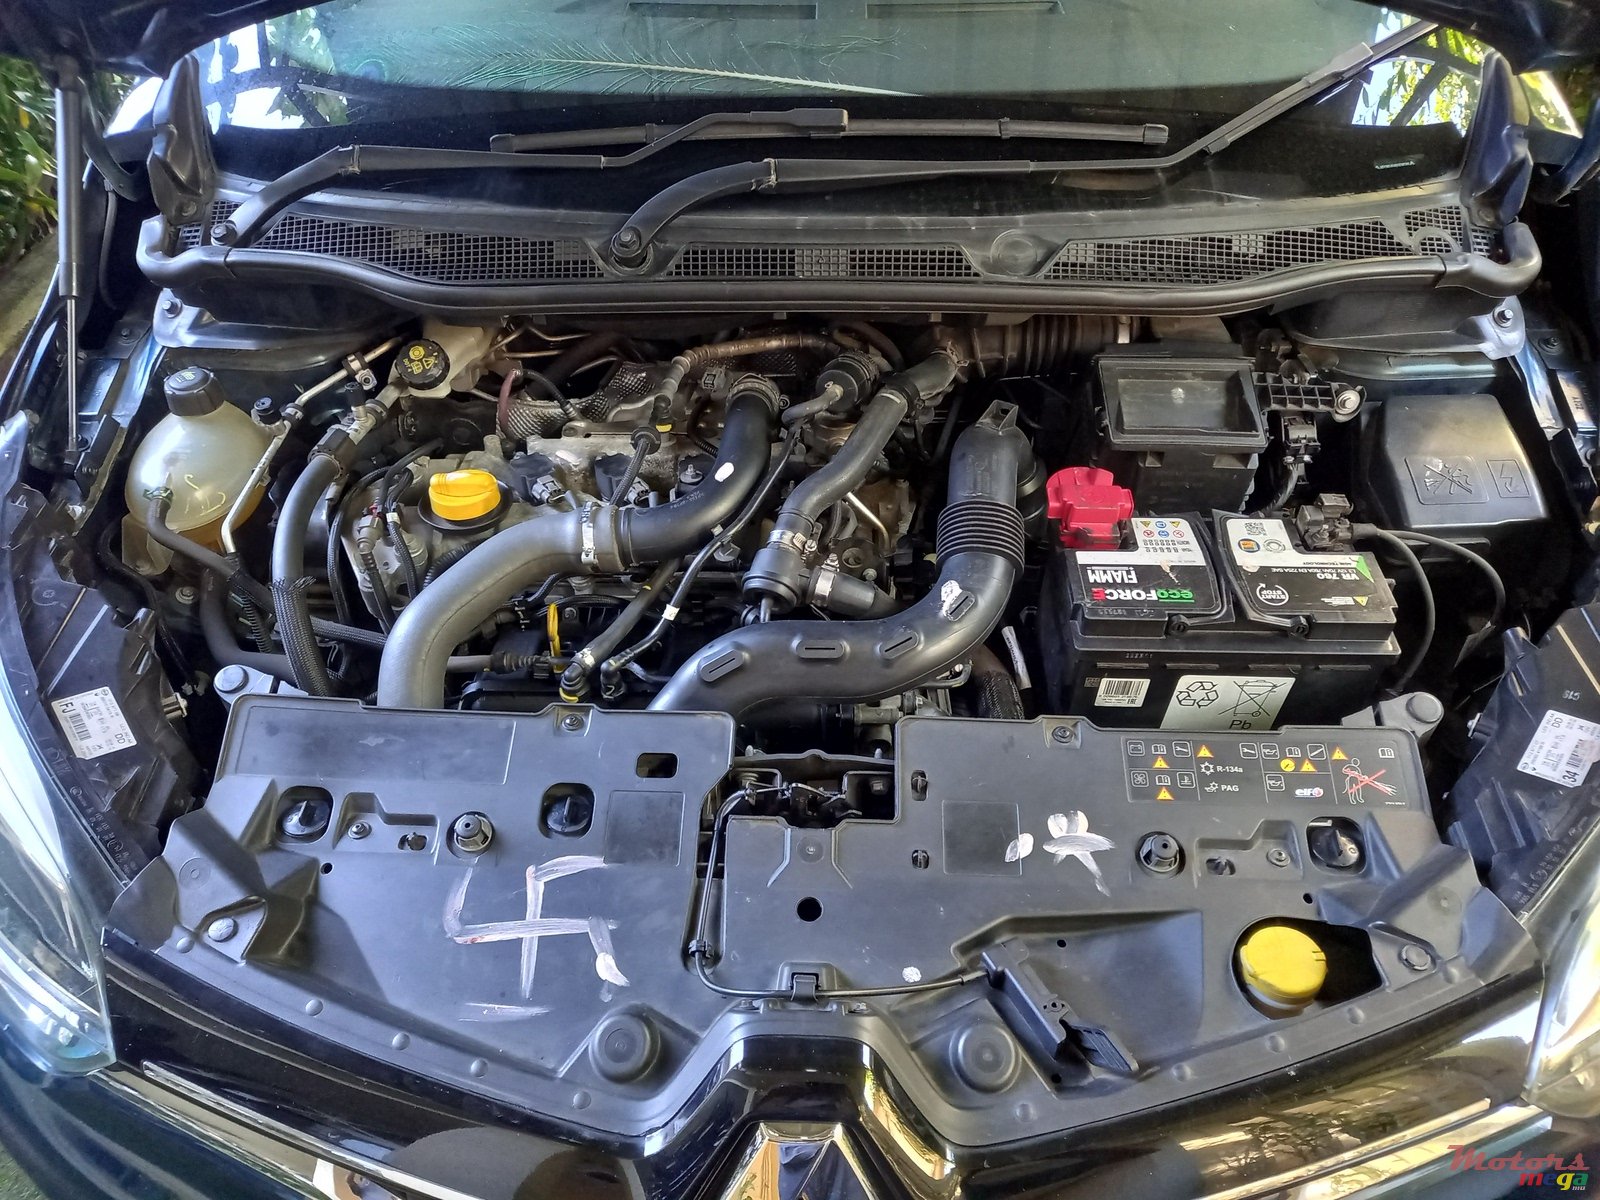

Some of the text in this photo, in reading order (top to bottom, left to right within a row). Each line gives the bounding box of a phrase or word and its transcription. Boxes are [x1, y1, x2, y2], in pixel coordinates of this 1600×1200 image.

[1086, 568, 1138, 583] FIAMM
[59, 702, 76, 714] FJ
[1228, 719, 1252, 730] Pb
[1216, 764, 1243, 774] R-134a
[1562, 770, 1580, 783] 34
[1220, 784, 1240, 792] PAG
